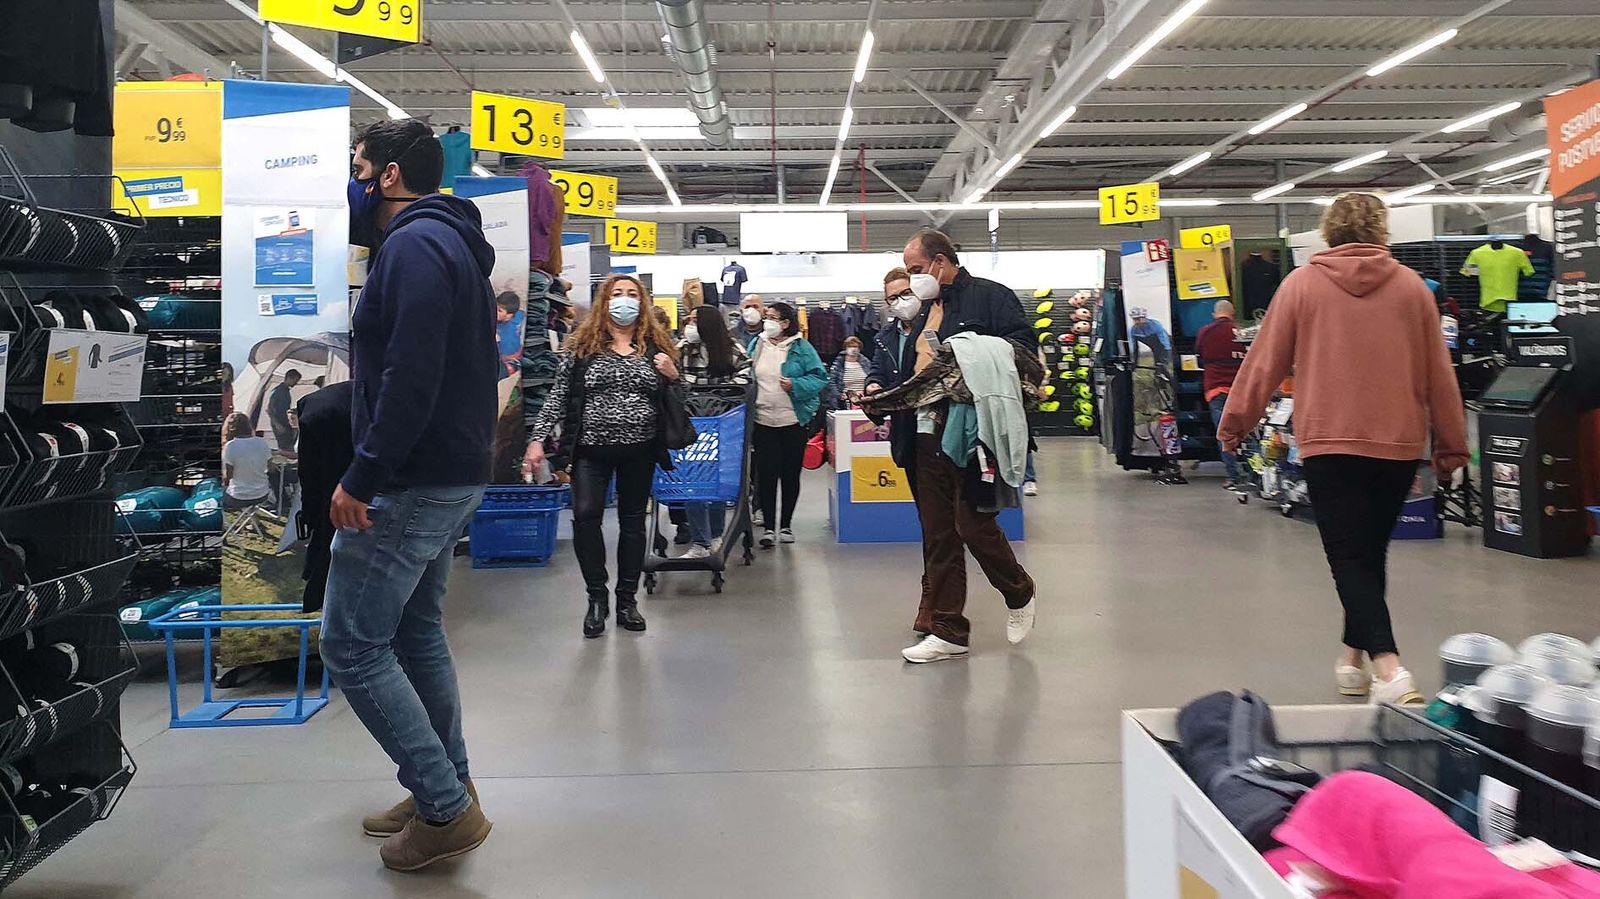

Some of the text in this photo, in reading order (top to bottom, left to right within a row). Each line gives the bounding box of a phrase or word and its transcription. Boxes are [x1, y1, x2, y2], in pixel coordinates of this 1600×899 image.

[378, 2, 411, 25] 99
[157, 118, 171, 143] 9
[172, 131, 186, 142] 99
[483, 105, 561, 148] 13 € 99
[265, 154, 318, 169] CAMPING
[1108, 192, 1138, 218] 15
[611, 226, 640, 248] 12
[878, 471, 888, 487] 6
